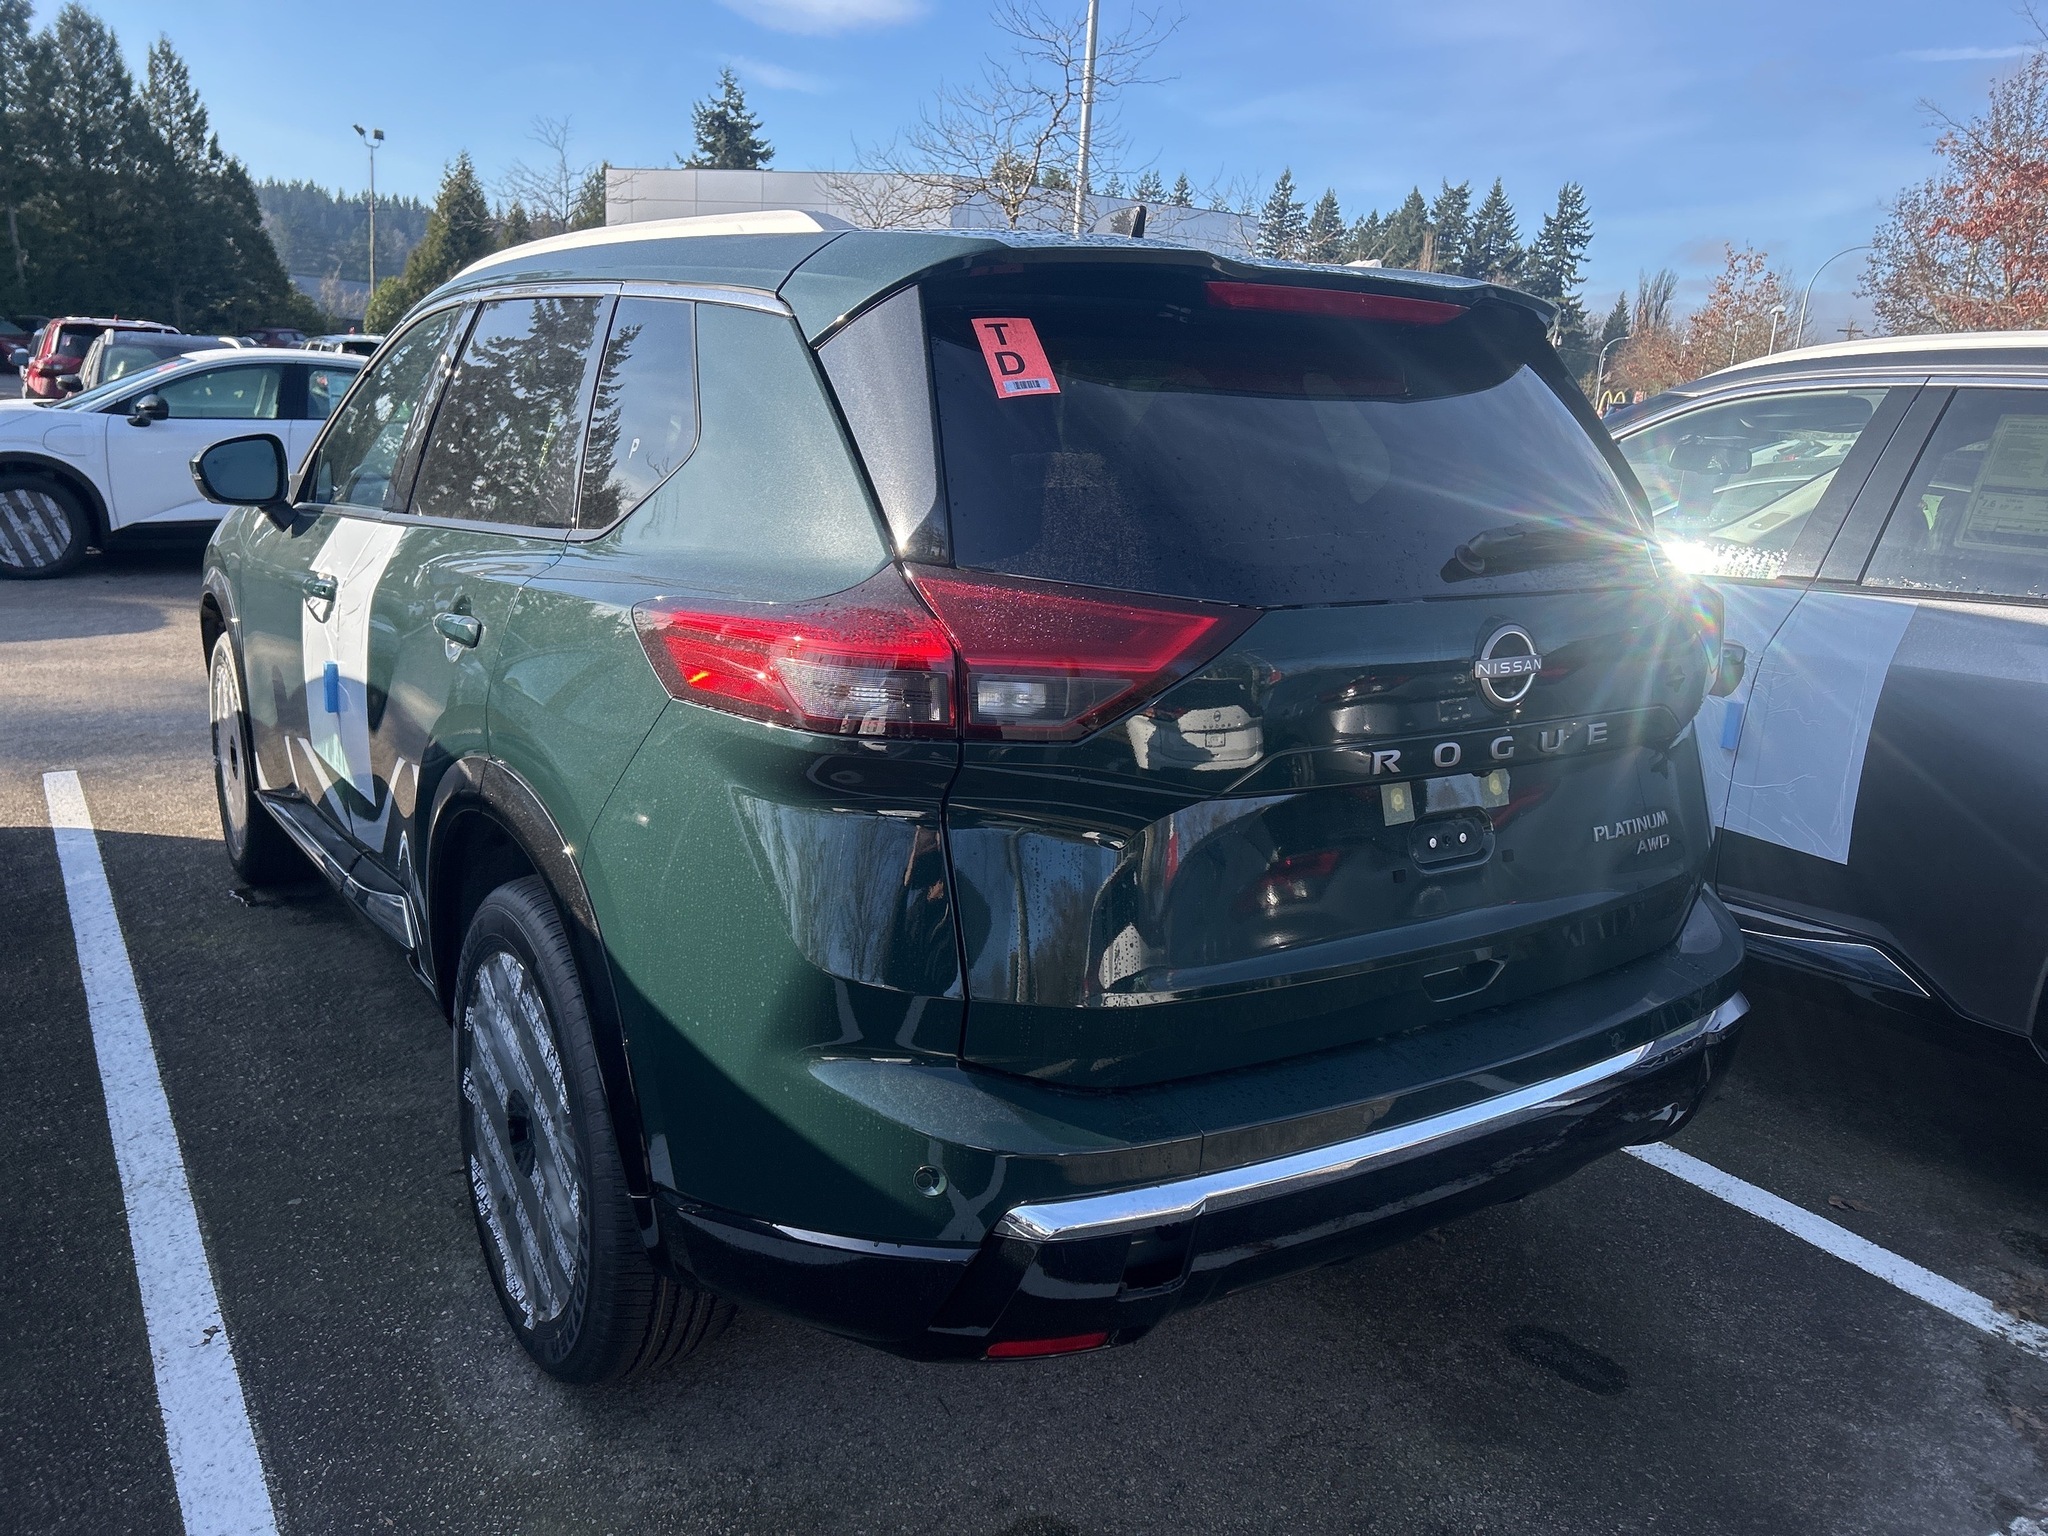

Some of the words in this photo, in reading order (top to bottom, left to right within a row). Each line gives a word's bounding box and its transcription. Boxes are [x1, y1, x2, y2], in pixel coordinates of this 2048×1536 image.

[1478, 658, 1542, 675] NISSAN
[1370, 722, 1608, 775] ROGUE
[1593, 810, 1669, 842] PLATINUM
[1636, 833, 1671, 855] AWD
